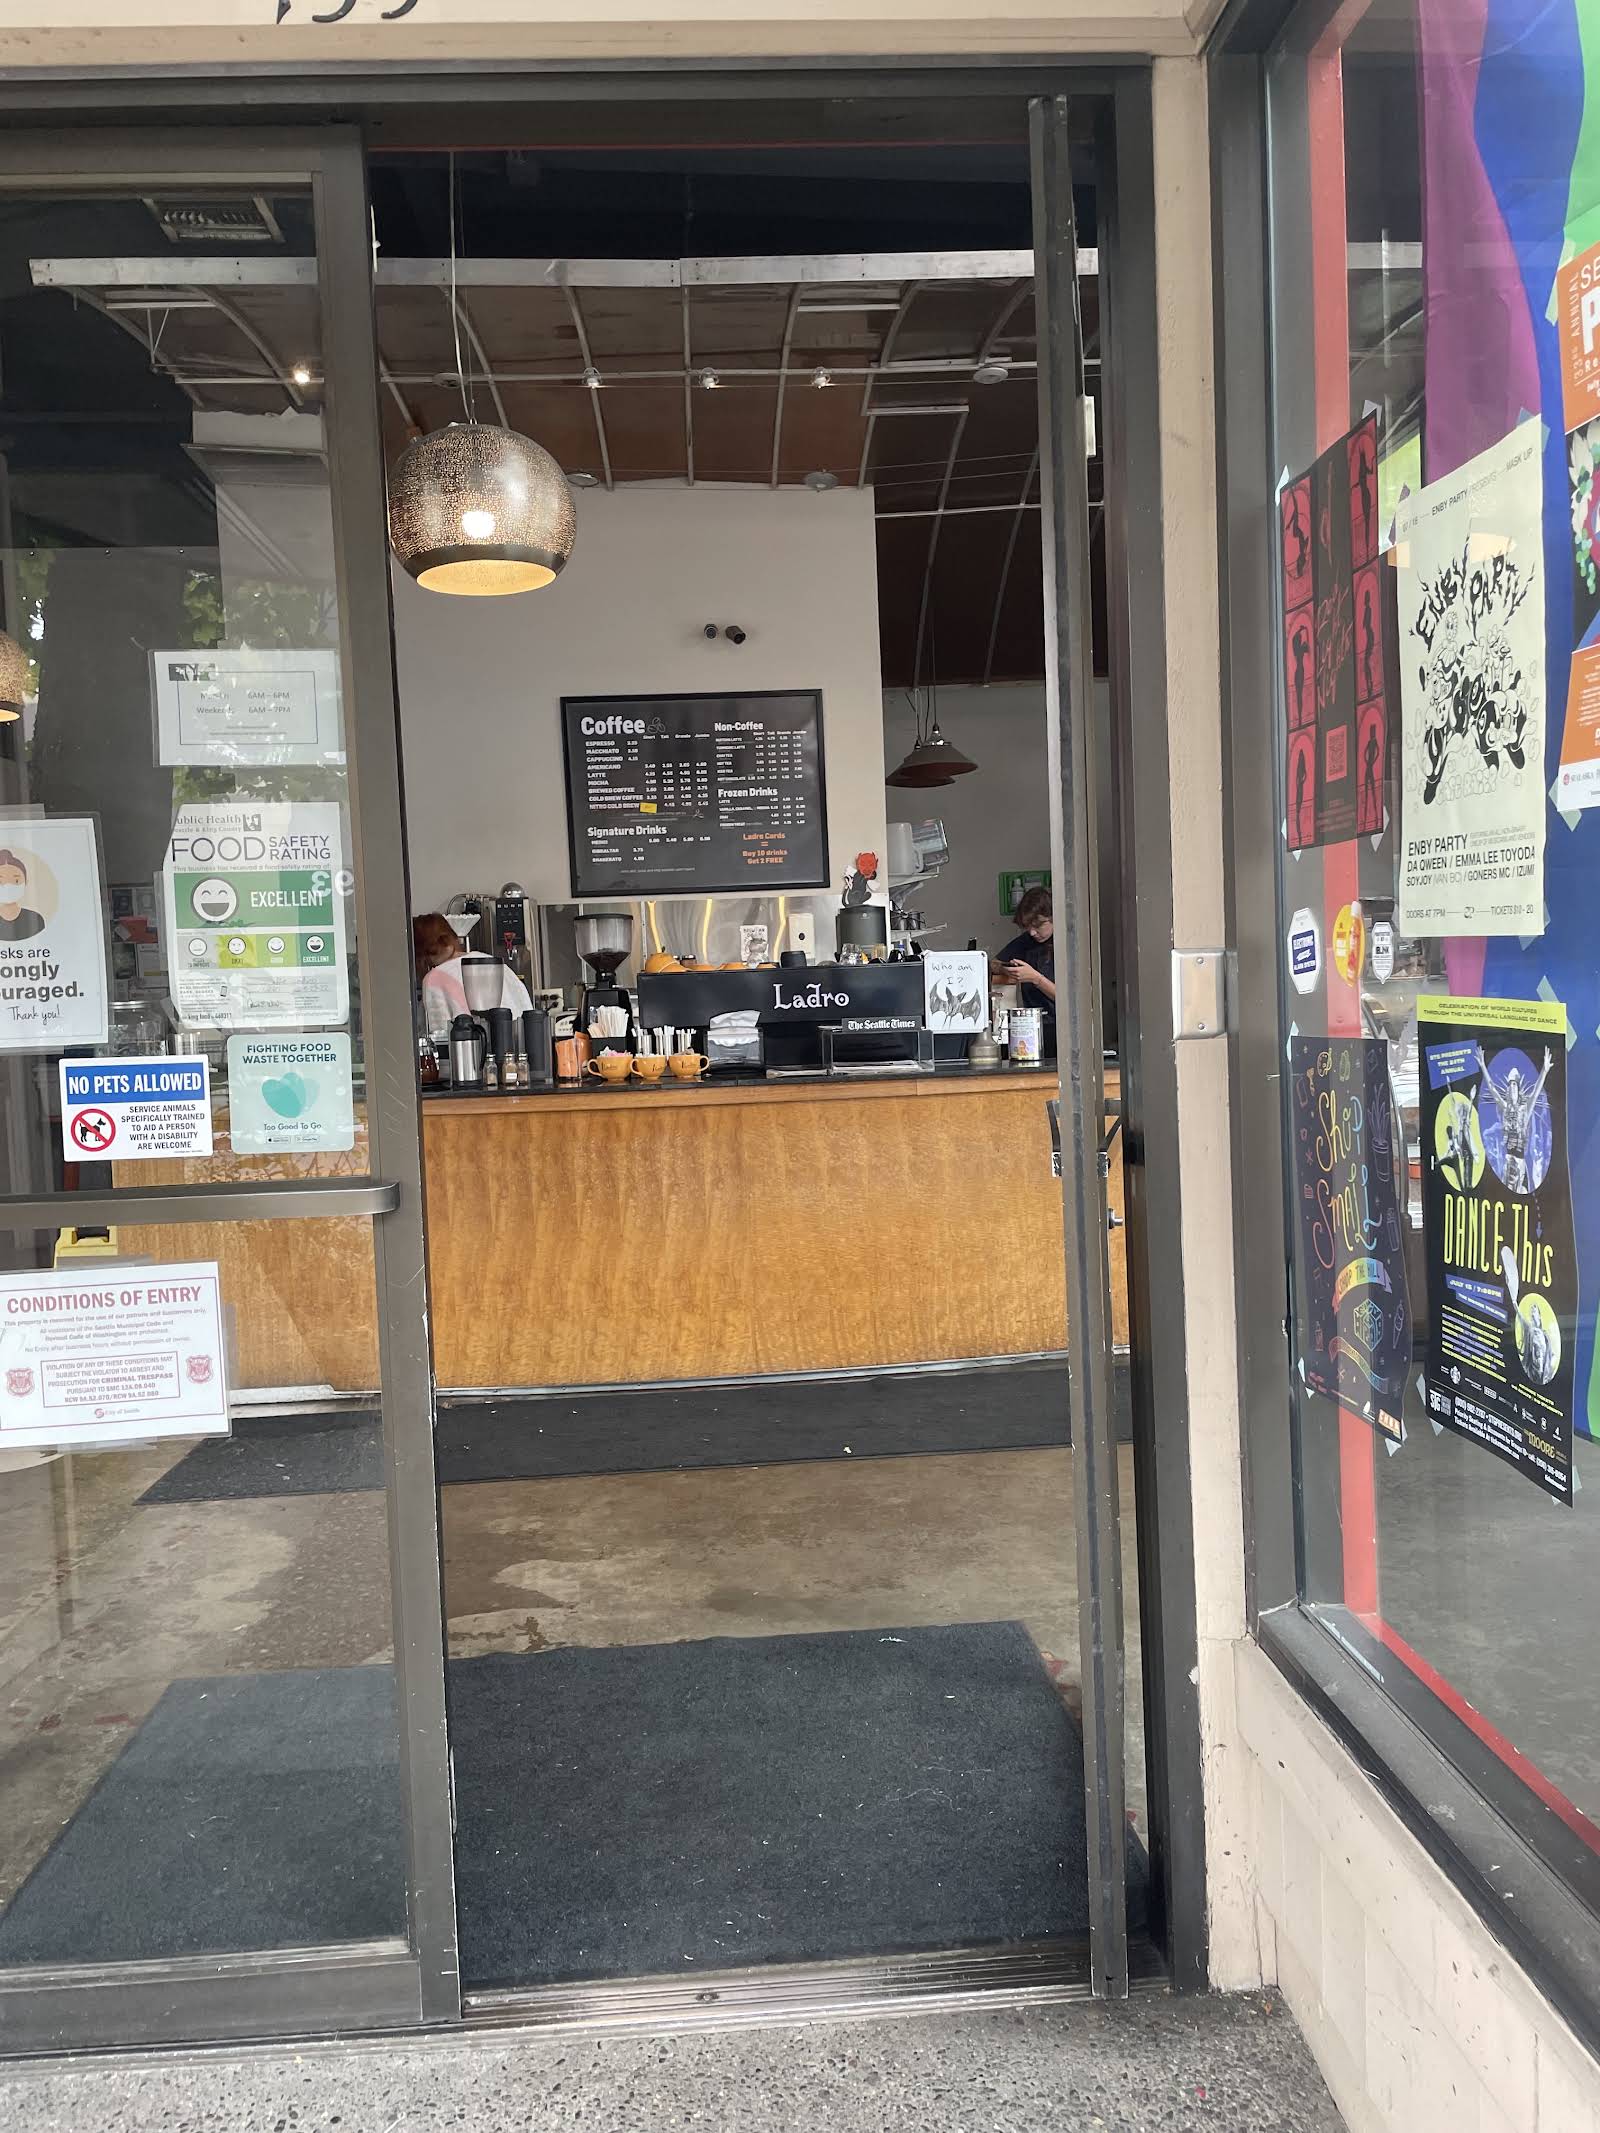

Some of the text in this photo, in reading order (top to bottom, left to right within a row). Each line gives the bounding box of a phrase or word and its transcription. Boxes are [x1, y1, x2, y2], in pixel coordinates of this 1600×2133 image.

[1524, 447, 1534, 461] UP
[1432, 488, 1468, 516] ENBY PARTY
[1467, 545, 1535, 642] PARTY
[581, 715, 646, 735] Coffee
[714, 722, 764, 732] Non-Coffee
[718, 787, 778, 798] Frozen Drinks
[206, 814, 242, 824] Health
[587, 825, 667, 838] Signature Drinks
[268, 835, 330, 848] SAFETY
[1408, 839, 1432, 856] ENBY
[1434, 834, 1468, 853] PARTY
[171, 836, 266, 862] FOOD
[270, 848, 331, 861] RATING
[766, 848, 788, 856] drinks
[1407, 846, 1535, 872] DA QWEEN EMMA LEE TOYODA
[1406, 864, 1535, 886] SOYJOY GONERS MC IZUMI
[250, 890, 324, 908] EXCELLENT
[1490, 905, 1513, 916] TICKETS
[28, 948, 50, 958] are
[0, 981, 84, 1002] uraged.
[772, 983, 850, 1010] Ladro
[8, 1004, 60, 1026] Thank you!
[1512, 1006, 1538, 1014] CULTURES
[1464, 1012, 1498, 1020] UNIVERSAL
[1500, 1014, 1529, 1022] LANGUAGE
[848, 1018, 916, 1031] The Seattle Times
[247, 1043, 332, 1054] FIGHTING FOOD
[1442, 1048, 1472, 1059] PRESENTS
[242, 1054, 336, 1064] WASTE TOGETHER
[1440, 1066, 1465, 1074] ANNUAL
[68, 1072, 202, 1095] NO PETS ALLOWED
[130, 1104, 196, 1114] SERVICE ANIMALS
[121, 1112, 205, 1123] SPECIFICALLY TRAINED
[132, 1124, 142, 1132] TO
[143, 1124, 158, 1132] AID
[166, 1122, 196, 1130] PERSON
[278, 1122, 298, 1130] Good
[301, 1122, 308, 1130] To
[130, 1134, 148, 1142] WITH
[158, 1131, 198, 1140] DISABILITY
[138, 1140, 192, 1150] ARE WELCOME
[1444, 1194, 1504, 1276] DANCE
[7, 1286, 201, 1314] CONDITIONS OF ENTRY
[96, 1360, 104, 1368] OF
[124, 1357, 159, 1366] CONDITIONS
[56, 1370, 80, 1378] SUBJECT
[92, 1368, 120, 1376] VIOLATOR
[152, 1364, 164, 1372] AND
[101, 1376, 136, 1384] CRIMINAL
[138, 1373, 173, 1381] TRESPASS
[1528, 1432, 1556, 1458] MOORE
